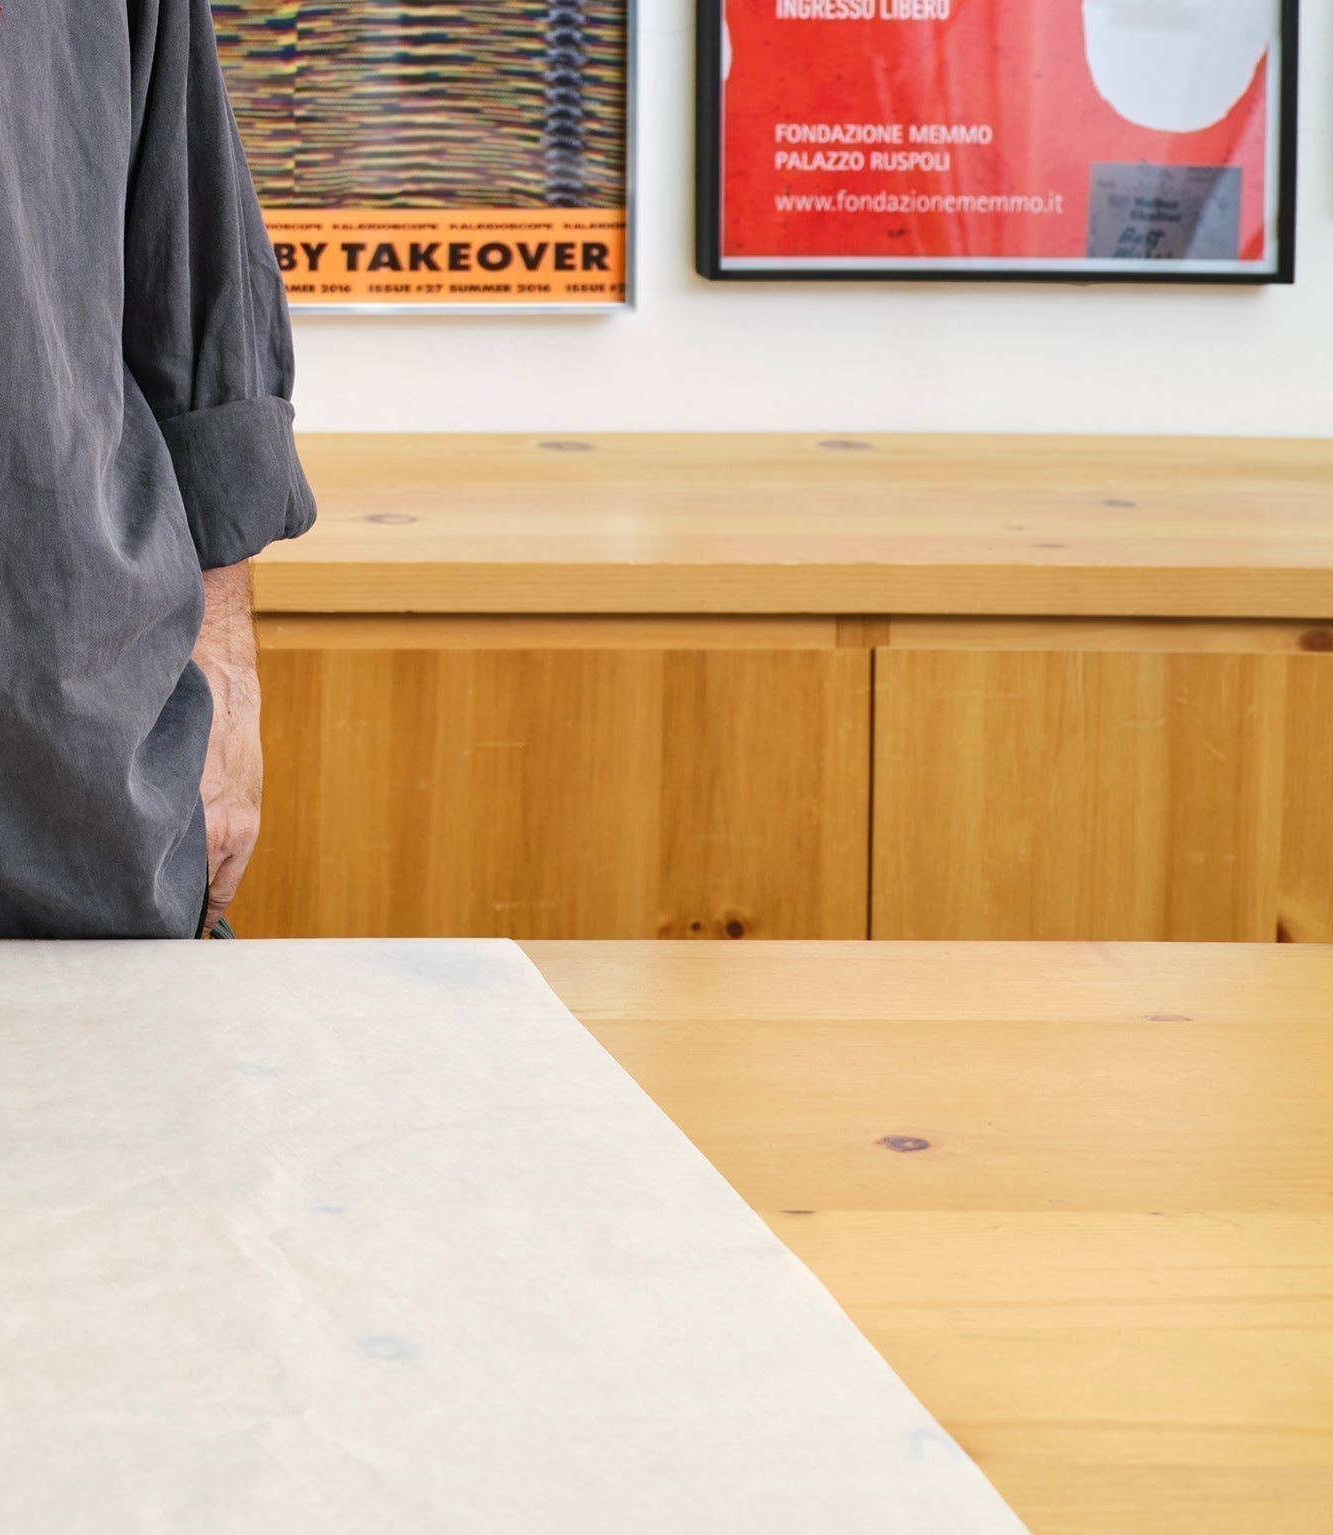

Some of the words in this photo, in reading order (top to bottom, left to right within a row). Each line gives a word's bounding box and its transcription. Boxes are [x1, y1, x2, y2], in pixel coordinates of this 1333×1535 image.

[774, 123, 904, 144] FONDAZIONE
[908, 123, 994, 144] MEMMO
[774, 151, 866, 172] PALAZZO
[870, 151, 951, 172] RUSPOLI
[774, 189, 1064, 214] www.fondazionememmo.it
[341, 242, 612, 272] TAKEOVER
[448, 284, 512, 294] SUMMER
